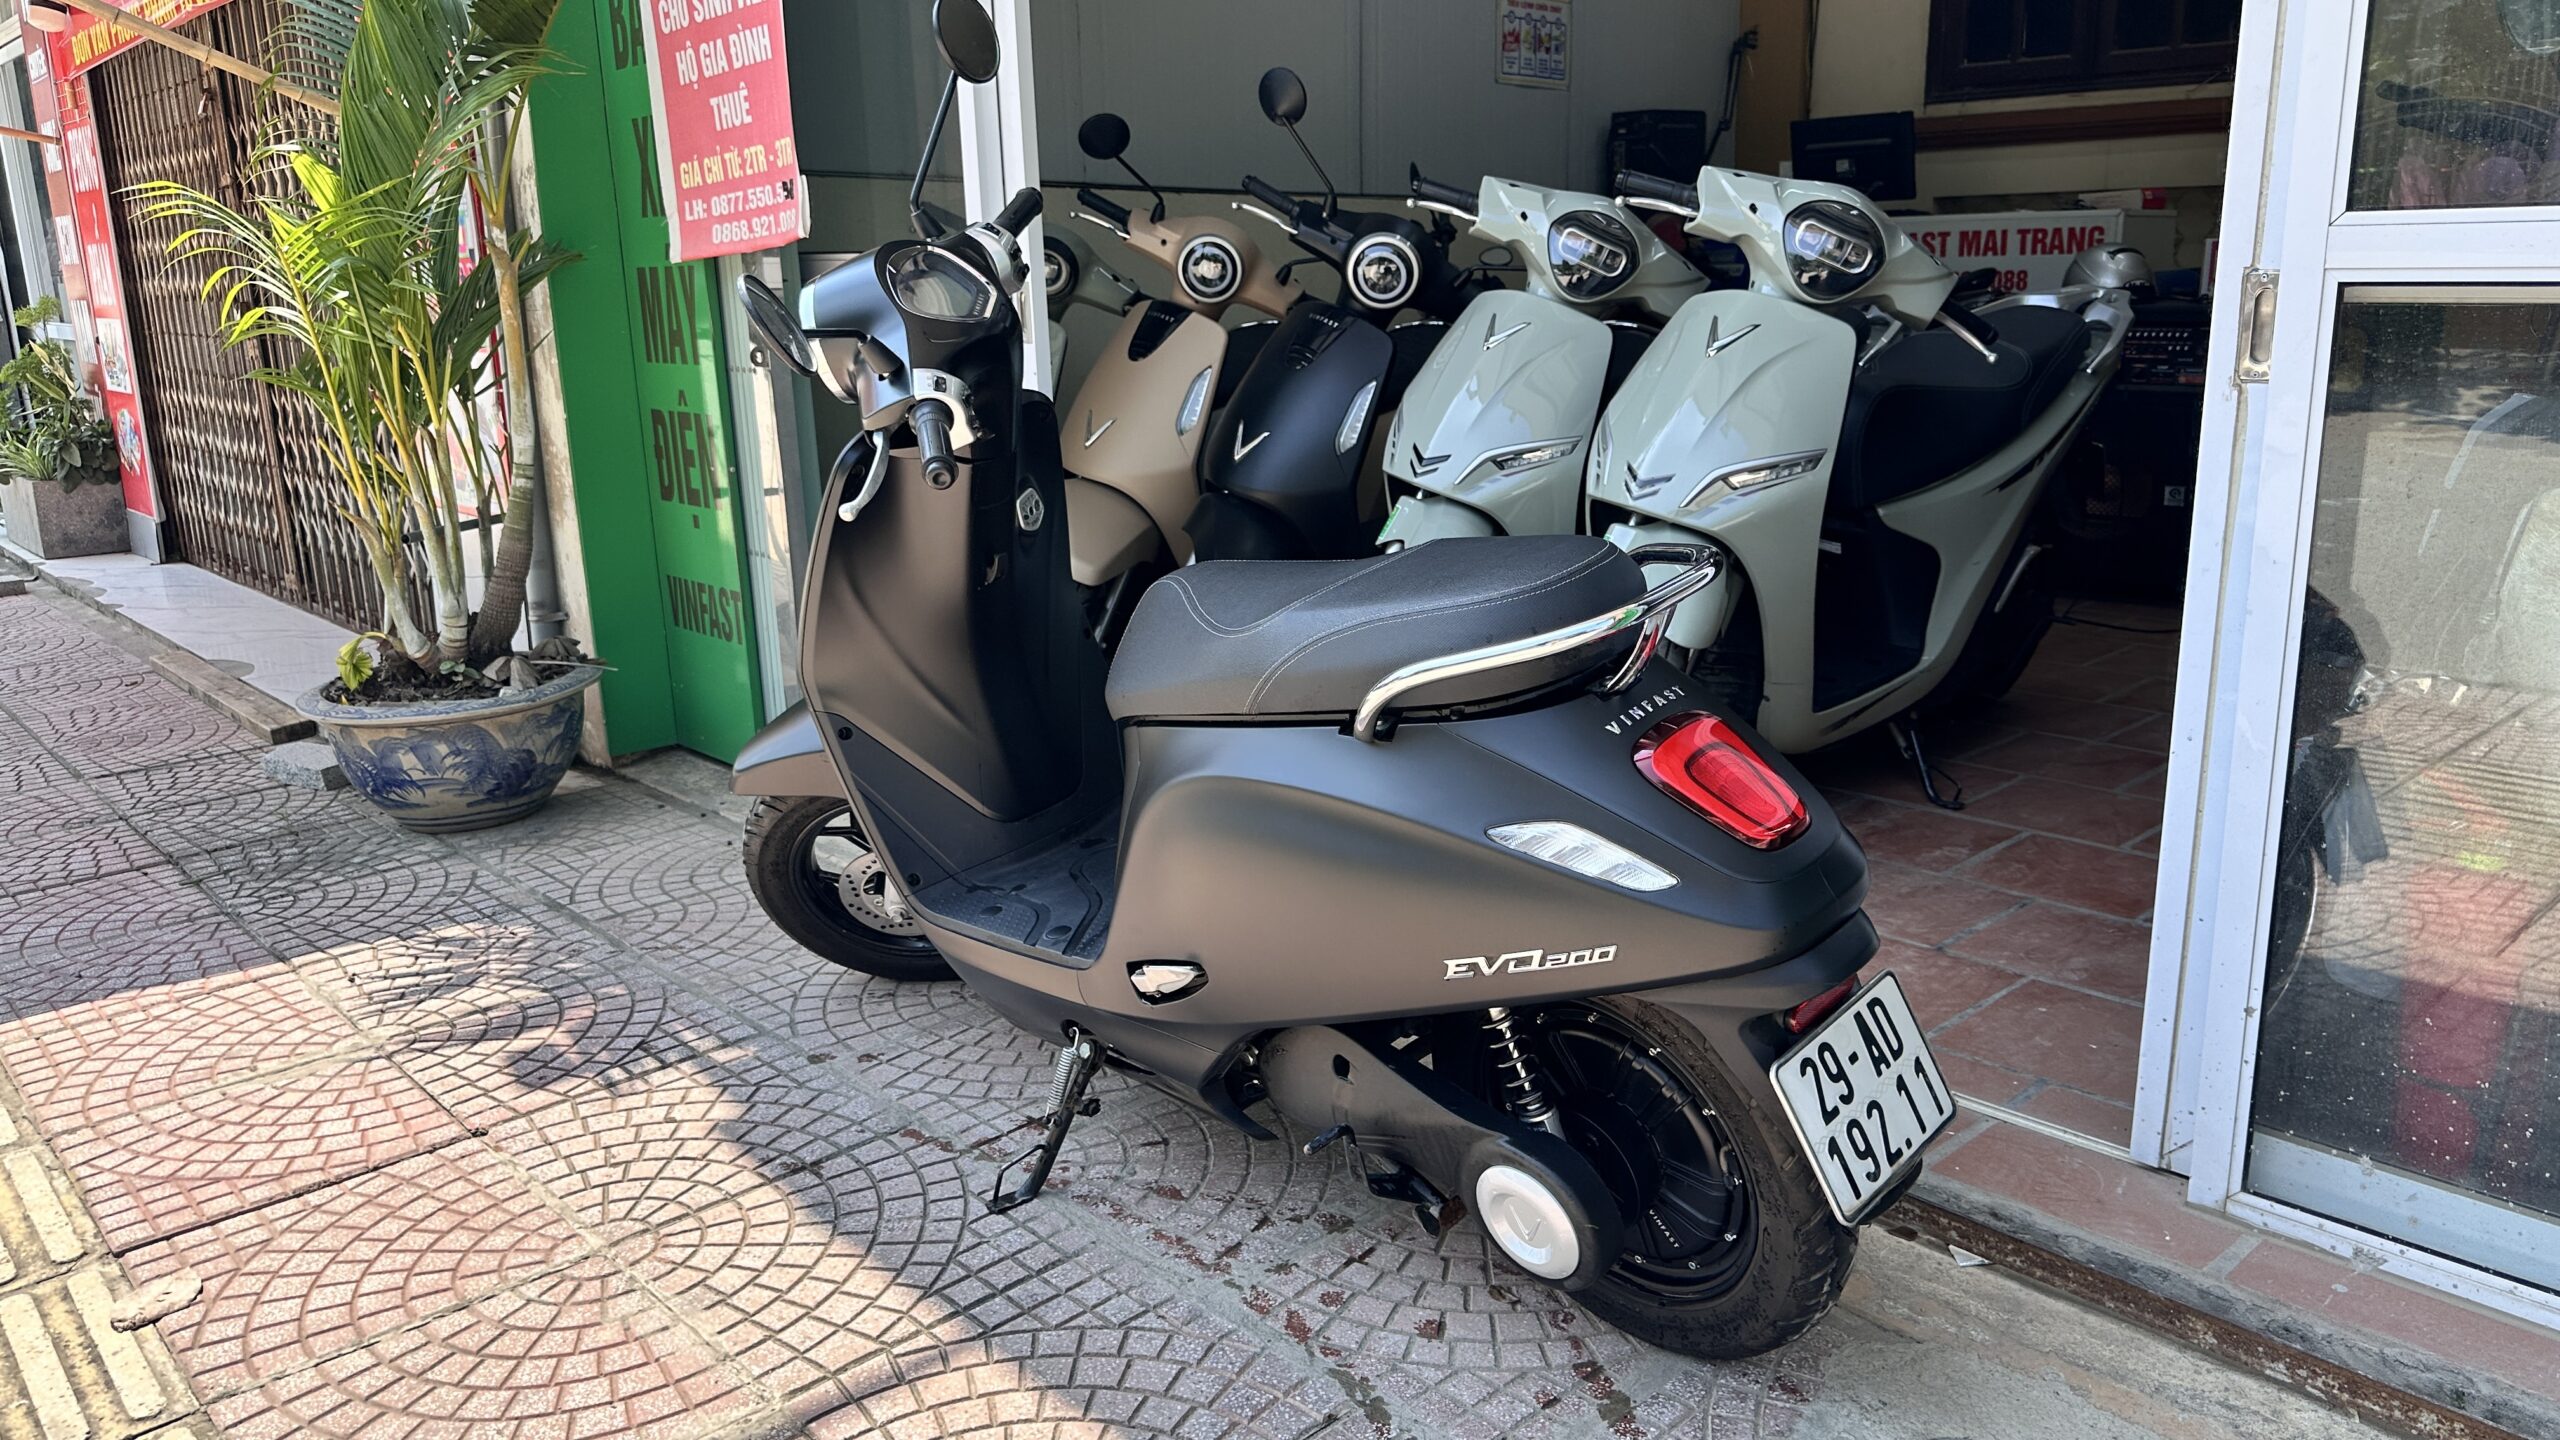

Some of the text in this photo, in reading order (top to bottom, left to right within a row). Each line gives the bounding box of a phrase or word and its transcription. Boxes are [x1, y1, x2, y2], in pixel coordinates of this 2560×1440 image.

[675, 23, 772, 90] HỘ GIA ĐÌNH
[709, 81, 752, 131] THUÊ
[680, 154, 703, 189] GIÁ
[703, 145, 724, 184] CHỈ
[723, 145, 744, 180] TỪ:
[743, 144, 768, 175] 2TR
[774, 136, 793, 168] 3TR
[684, 179, 794, 221] LH: 0877.550.5
[1958, 229, 2008, 258] MAI
[2016, 225, 2106, 256] TRANG
[651, 389, 722, 530] ĐIỆN
[666, 574, 743, 646] VINFAST
[1604, 685, 1685, 735] VINFAST
[1800, 996, 1904, 1126] 29-AD
[1828, 1055, 1945, 1200] 192.11
